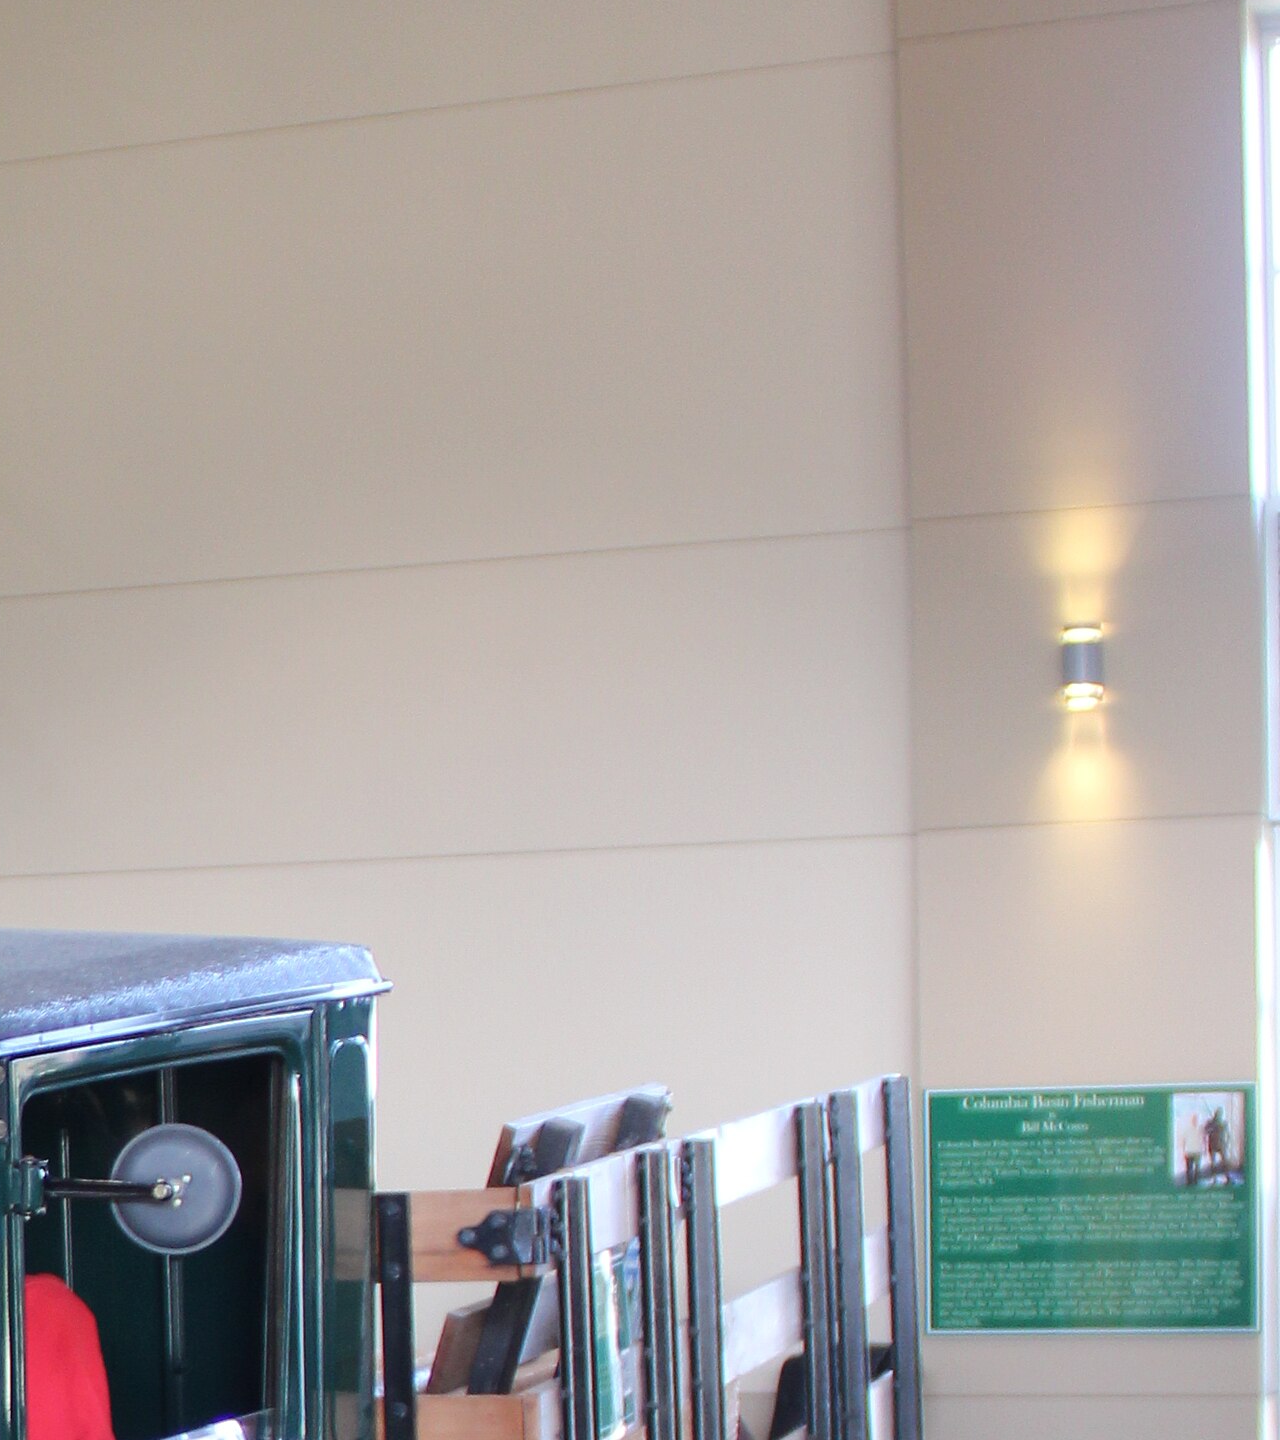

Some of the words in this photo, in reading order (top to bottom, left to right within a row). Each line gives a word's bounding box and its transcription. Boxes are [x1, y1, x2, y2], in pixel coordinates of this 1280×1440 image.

[962, 1094, 1029, 1111] Columbia
[1033, 1094, 1069, 1109] Basin
[1074, 1092, 1145, 1108] Fisherman
